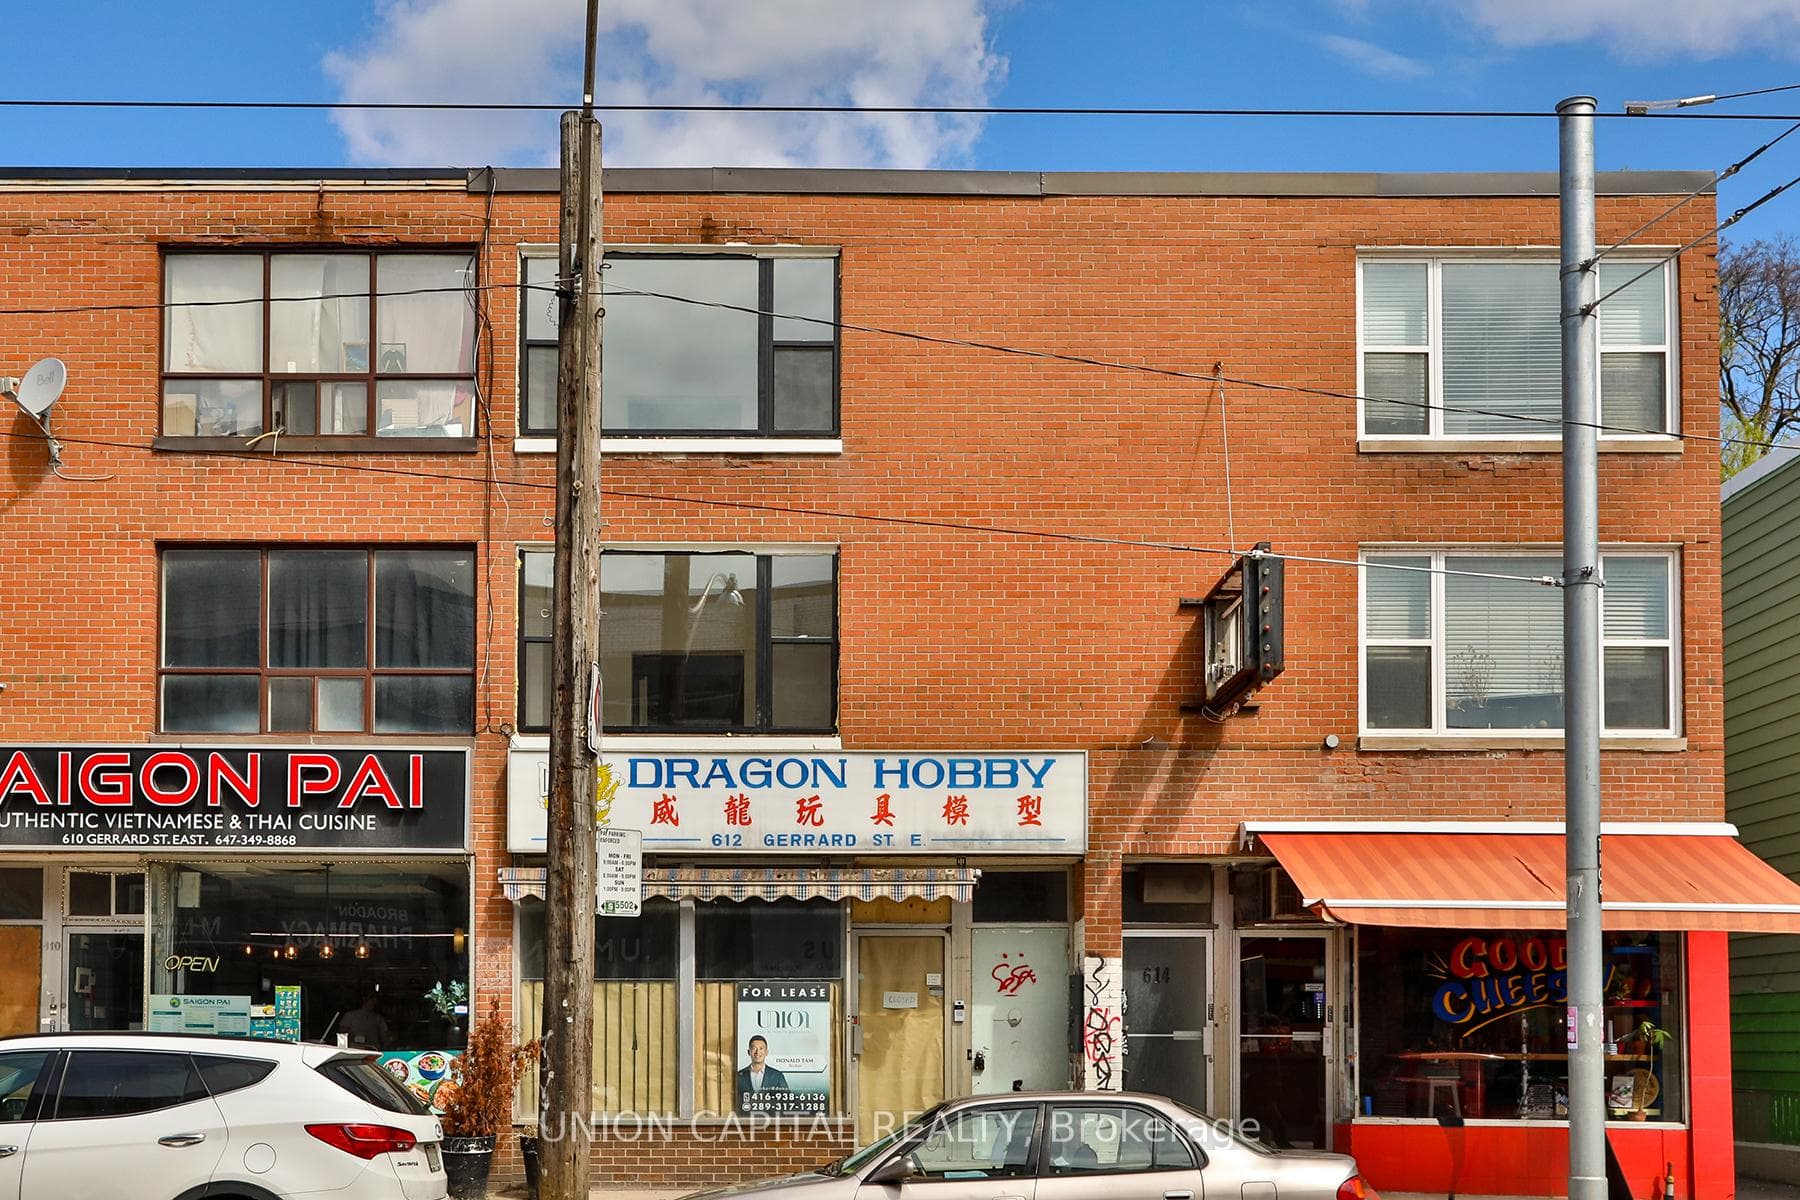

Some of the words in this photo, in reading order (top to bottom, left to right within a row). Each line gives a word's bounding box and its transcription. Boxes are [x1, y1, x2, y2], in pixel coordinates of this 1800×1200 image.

[287, 753, 424, 808] PAI
[628, 758, 847, 789] DRAGON
[873, 758, 1057, 789] HOBBY
[104, 813, 224, 829] VIETNAMESE
[229, 814, 242, 830] &
[245, 814, 292, 830] THAI
[299, 814, 376, 831] CUISINE
[62, 834, 84, 845] 610
[86, 834, 150, 845] GERRARD
[215, 834, 297, 846] 647-349-8868
[712, 833, 743, 847] 612
[764, 833, 857, 847] GERRARD
[615, 901, 634, 910] 5502
[164, 954, 221, 974] OPEN
[1143, 966, 1171, 984] 614
[742, 988, 771, 998] FOR
[781, 988, 826, 998] LEASE
[751, 1092, 826, 1101] 416-938-6136
[751, 1102, 826, 1111] 289-317-1288
